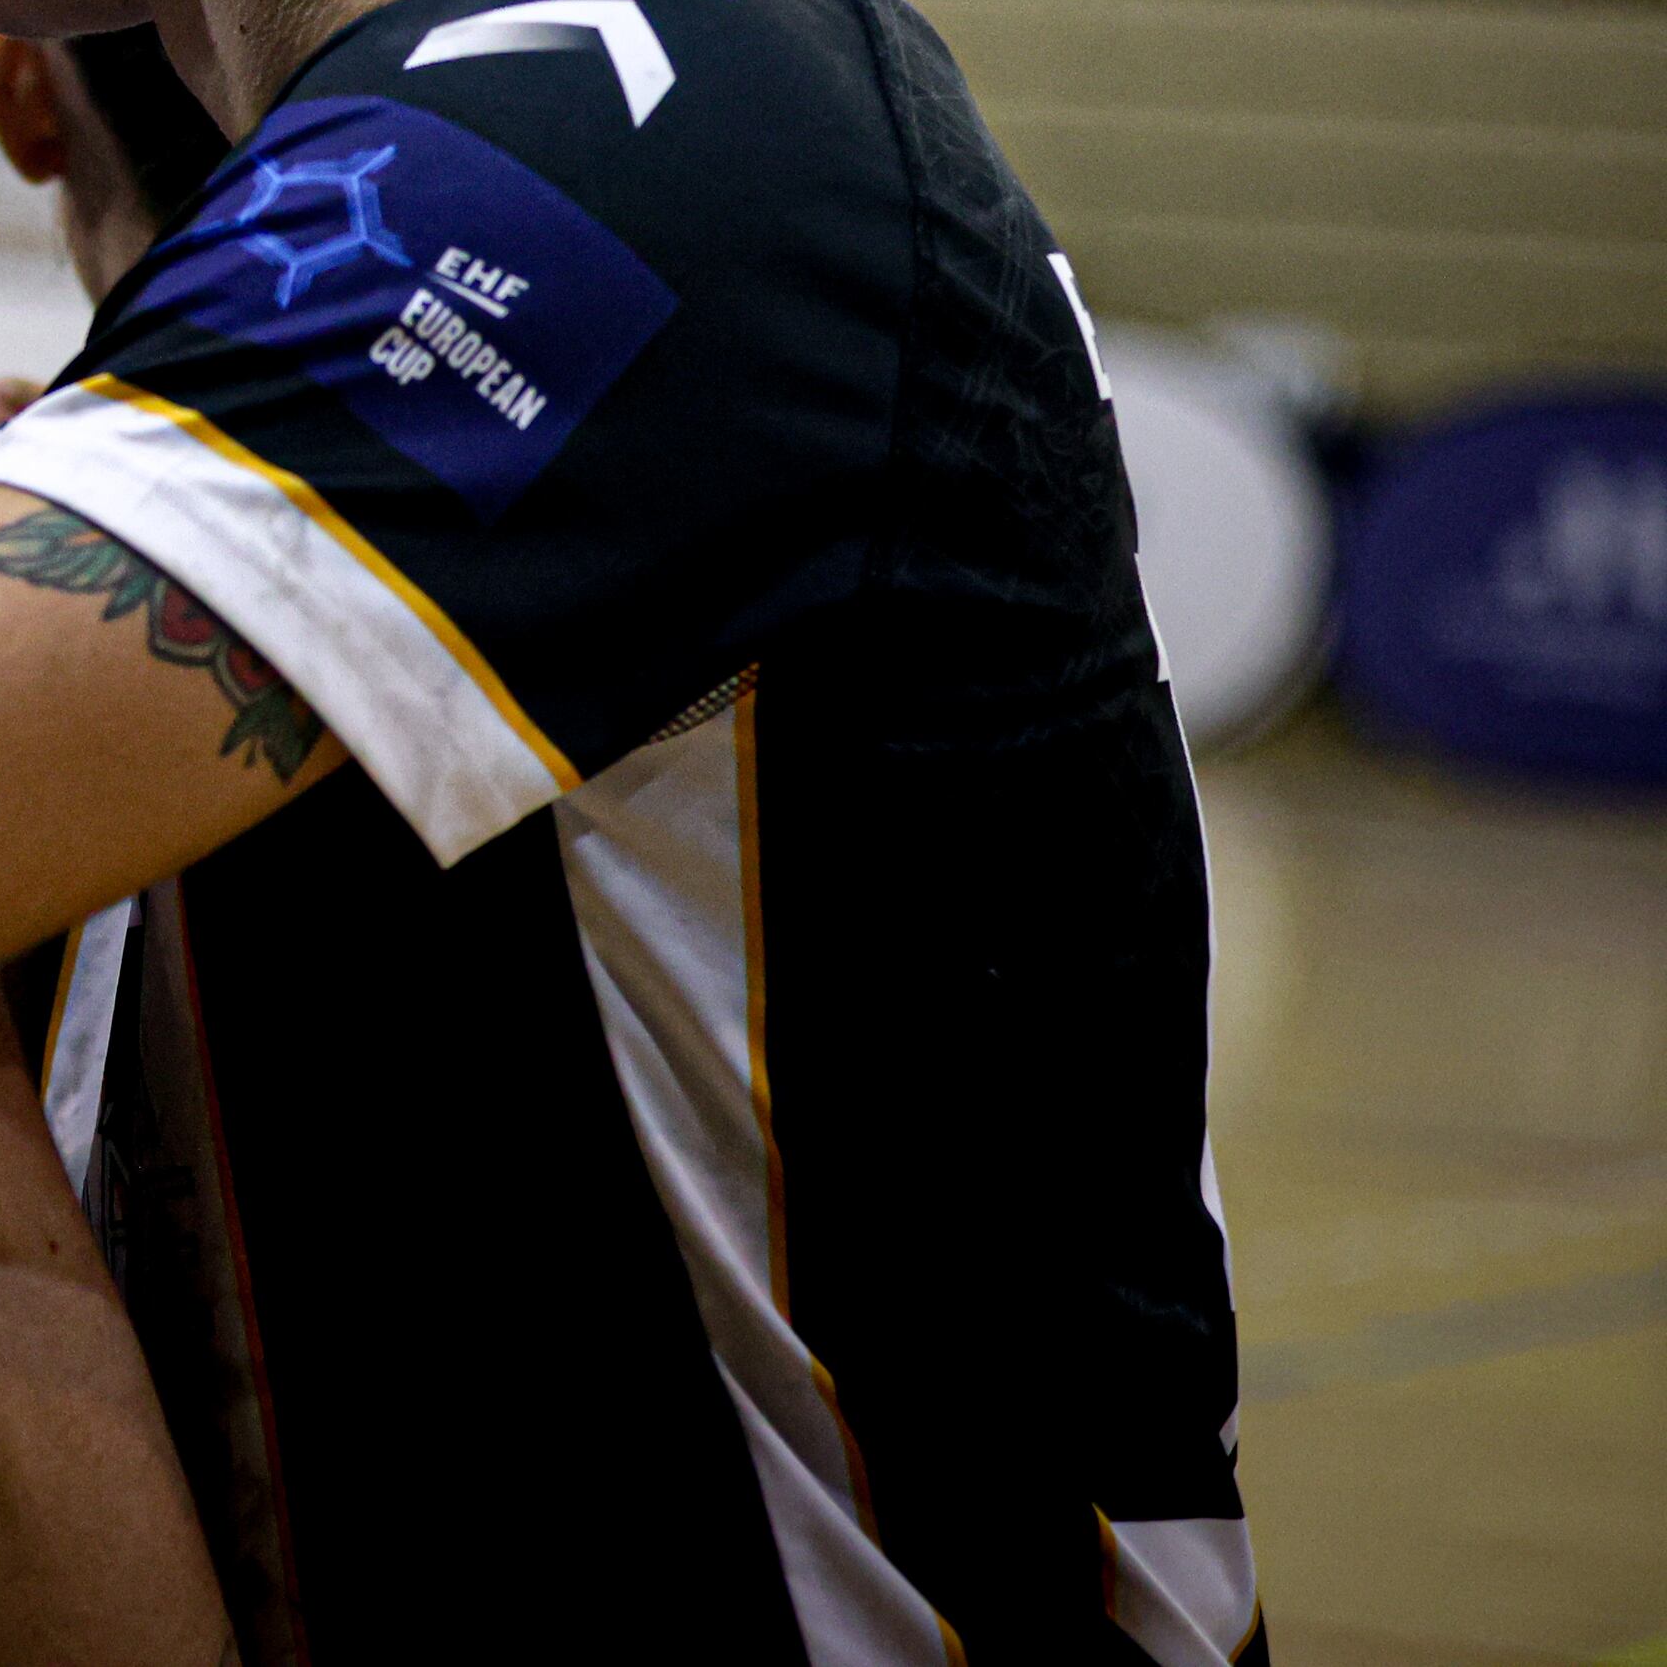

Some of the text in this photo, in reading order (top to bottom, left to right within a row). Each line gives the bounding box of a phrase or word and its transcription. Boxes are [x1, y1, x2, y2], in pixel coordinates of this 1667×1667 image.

[434, 245, 531, 302] EHF
[369, 324, 437, 386] CUP
[399, 288, 547, 431] EUROPEAN
